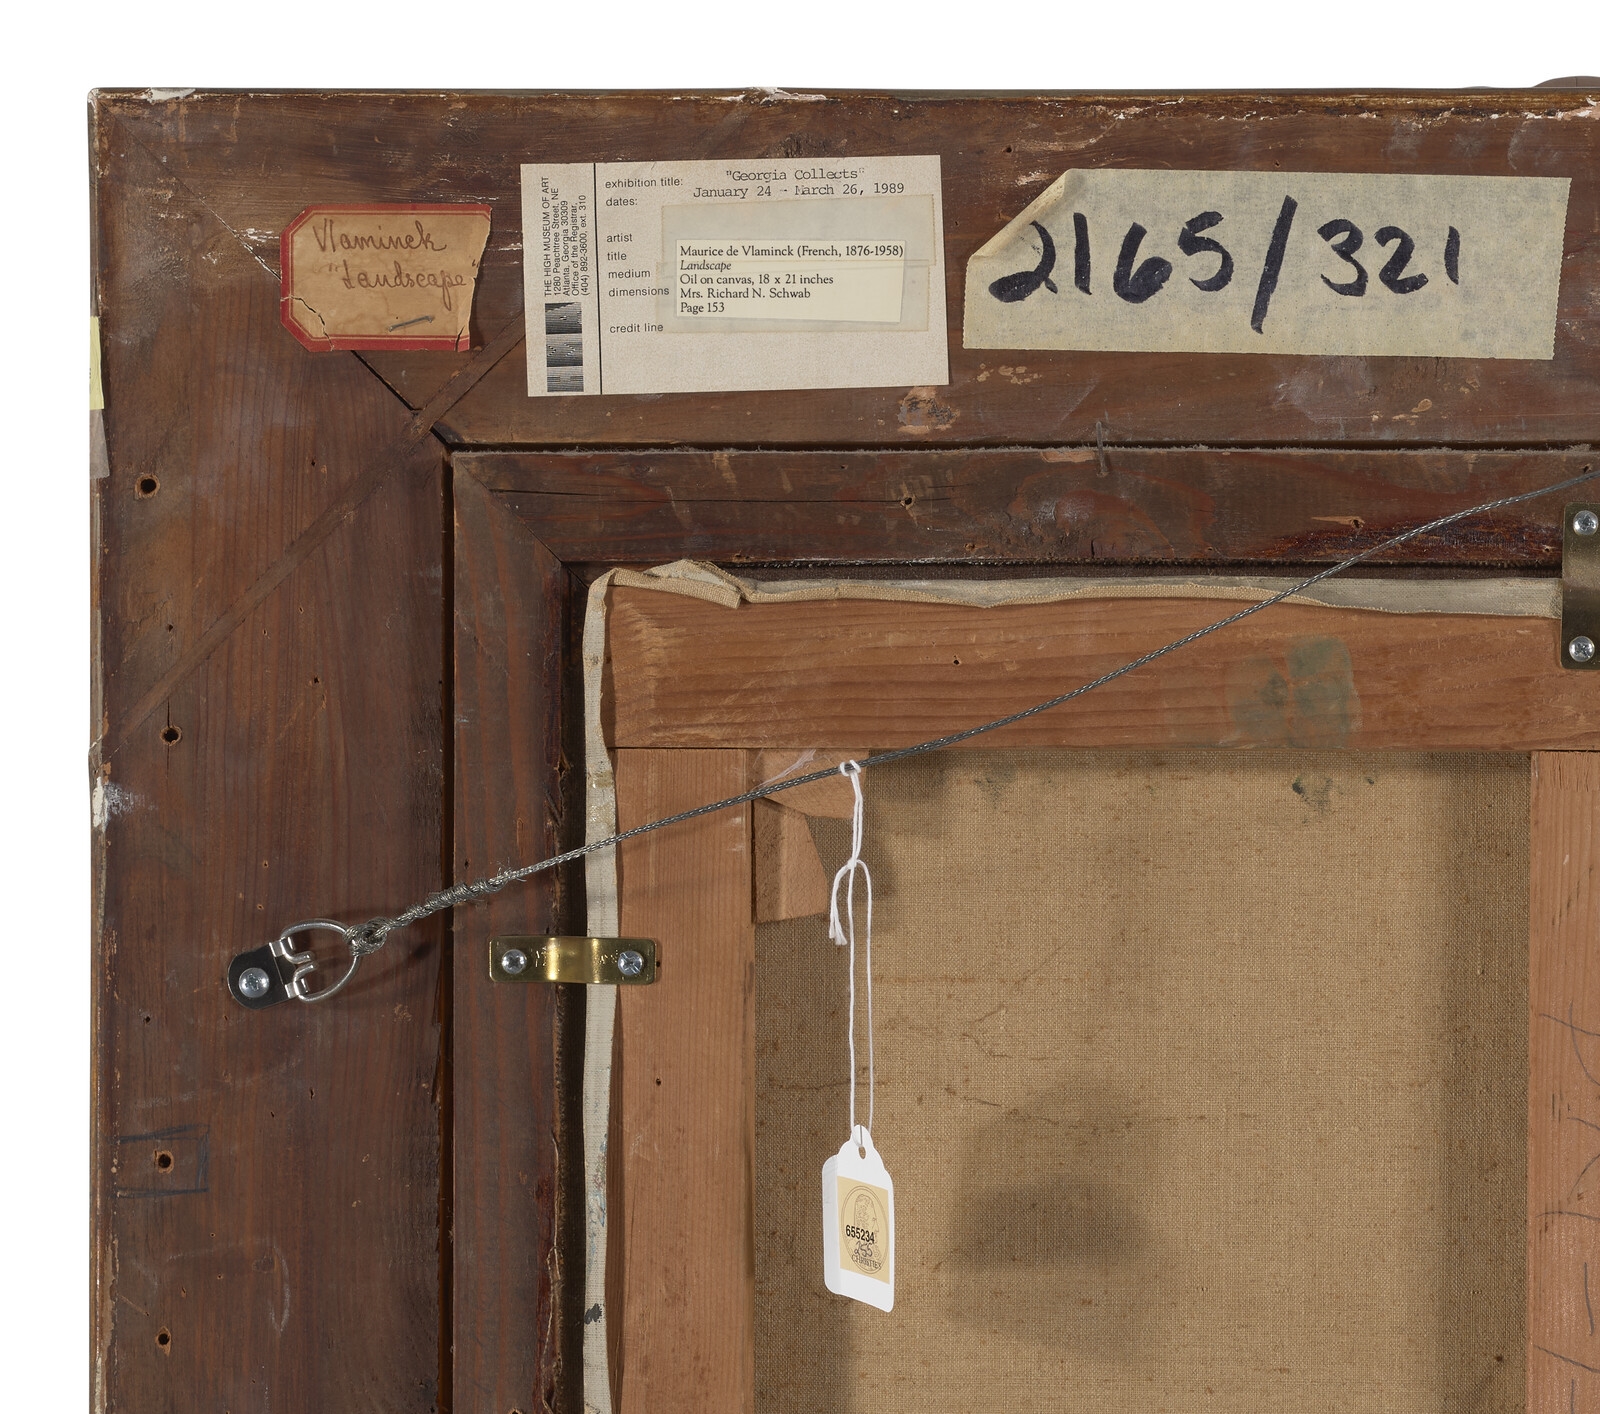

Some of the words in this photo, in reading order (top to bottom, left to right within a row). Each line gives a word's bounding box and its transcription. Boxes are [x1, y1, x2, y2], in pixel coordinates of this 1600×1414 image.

[726, 170, 787, 183] "Georgia
[794, 168, 865, 181] Collects"
[541, 176, 549, 194] ART
[605, 178, 657, 189] exhibition
[660, 177, 683, 187] title:
[551, 188, 559, 200] NE
[693, 186, 749, 199] January
[757, 186, 772, 197] 24
[795, 184, 835, 196] March
[843, 183, 864, 197] 26,
[873, 183, 905, 194] 1989
[542, 196, 550, 209] OF
[605, 196, 638, 207] dates:
[560, 200, 569, 226] 30309
[542, 211, 551, 251] MUSEUM
[606, 233, 633, 243] artist
[561, 228, 571, 262] Georgia
[571, 245, 579, 259] the
[679, 245, 724, 257] Maurice
[726, 244, 739, 257] de
[741, 244, 794, 257] Vlaminck
[797, 244, 842, 258] (French,
[845, 244, 904, 258] 1876-1958)
[552, 232, 561, 274] Peachtree
[607, 252, 627, 261] title
[543, 254, 551, 277] HIGH
[571, 260, 579, 269] of
[679, 260, 732, 272] Landscape
[987, 194, 1460, 335] 2165/321
[608, 269, 651, 279] medium
[679, 273, 697, 285] Oil
[700, 276, 714, 285] on
[716, 276, 755, 286] canvas,
[758, 274, 770, 285] 18
[774, 276, 781, 284] x
[785, 274, 796, 284] 21
[799, 273, 834, 285] inches
[544, 280, 552, 297] THE
[553, 276, 561, 296] 1280
[571, 271, 579, 296] Office
[580, 274, 590, 296] (404)
[608, 286, 670, 297] dimensions
[679, 288, 703, 299] Mrs.
[707, 287, 749, 299] Richard
[752, 288, 766, 299] N.
[769, 287, 811, 299] Schwab
[680, 301, 704, 315] Page
[707, 301, 725, 313] 153
[609, 323, 640, 333] credit
[644, 323, 664, 332] line
[845, 1224, 875, 1244] 655234
